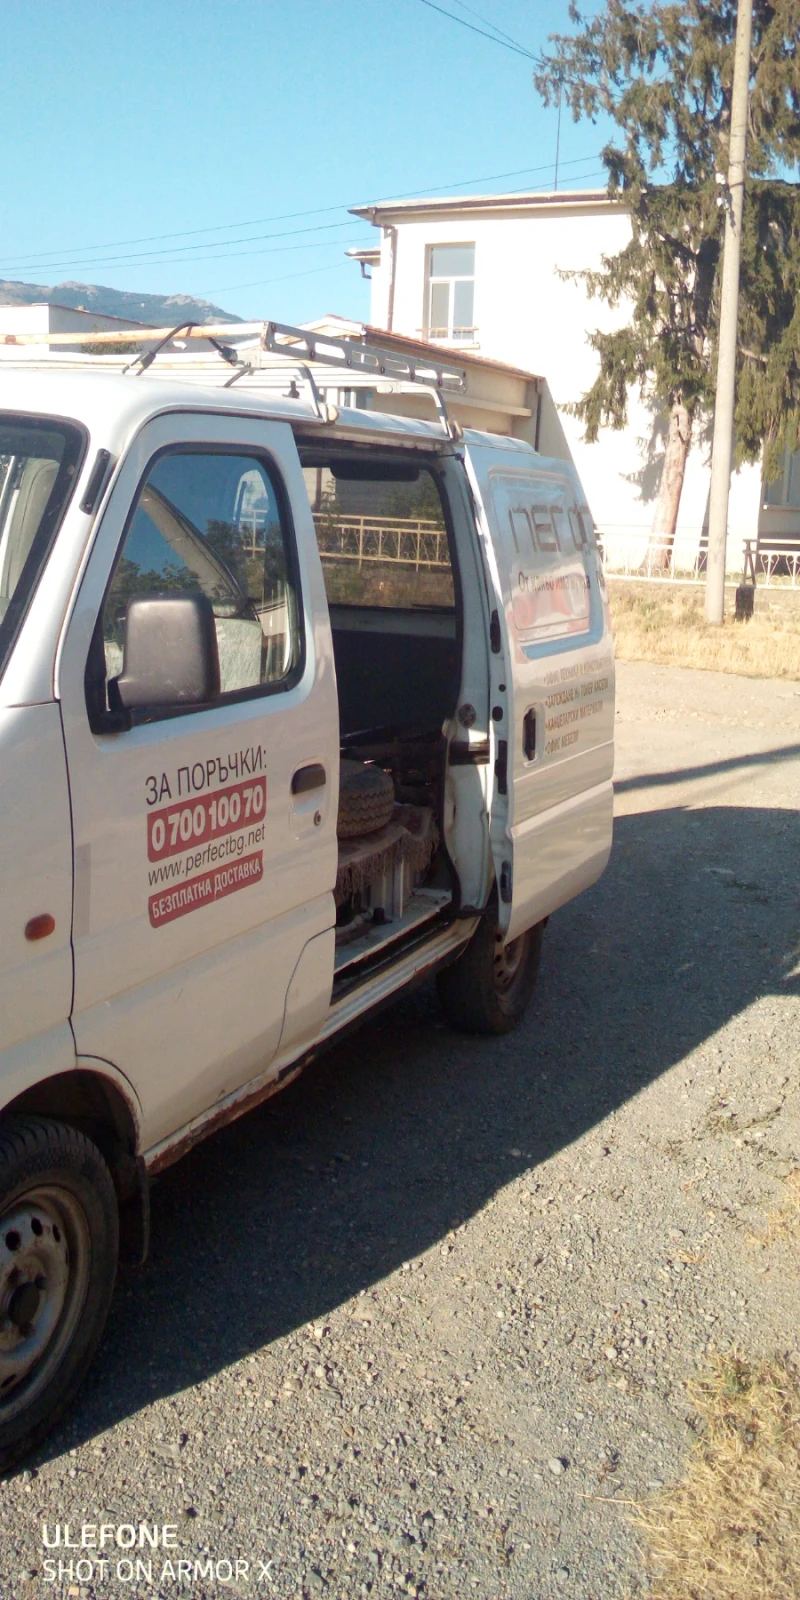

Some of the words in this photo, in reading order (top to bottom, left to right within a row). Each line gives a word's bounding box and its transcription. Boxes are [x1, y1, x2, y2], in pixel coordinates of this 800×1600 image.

[145, 773, 172, 806] ЗА
[177, 745, 267, 796] ПОРЪЧКИ:
[151, 818, 166, 851] 0
[168, 804, 206, 846] 700
[208, 792, 241, 830] 100
[243, 784, 264, 818] 70
[148, 823, 266, 887] www.perfectbg.net
[152, 878, 212, 919] БЕЗПЛАТНА
[213, 857, 261, 894] ДОСТАВКА
